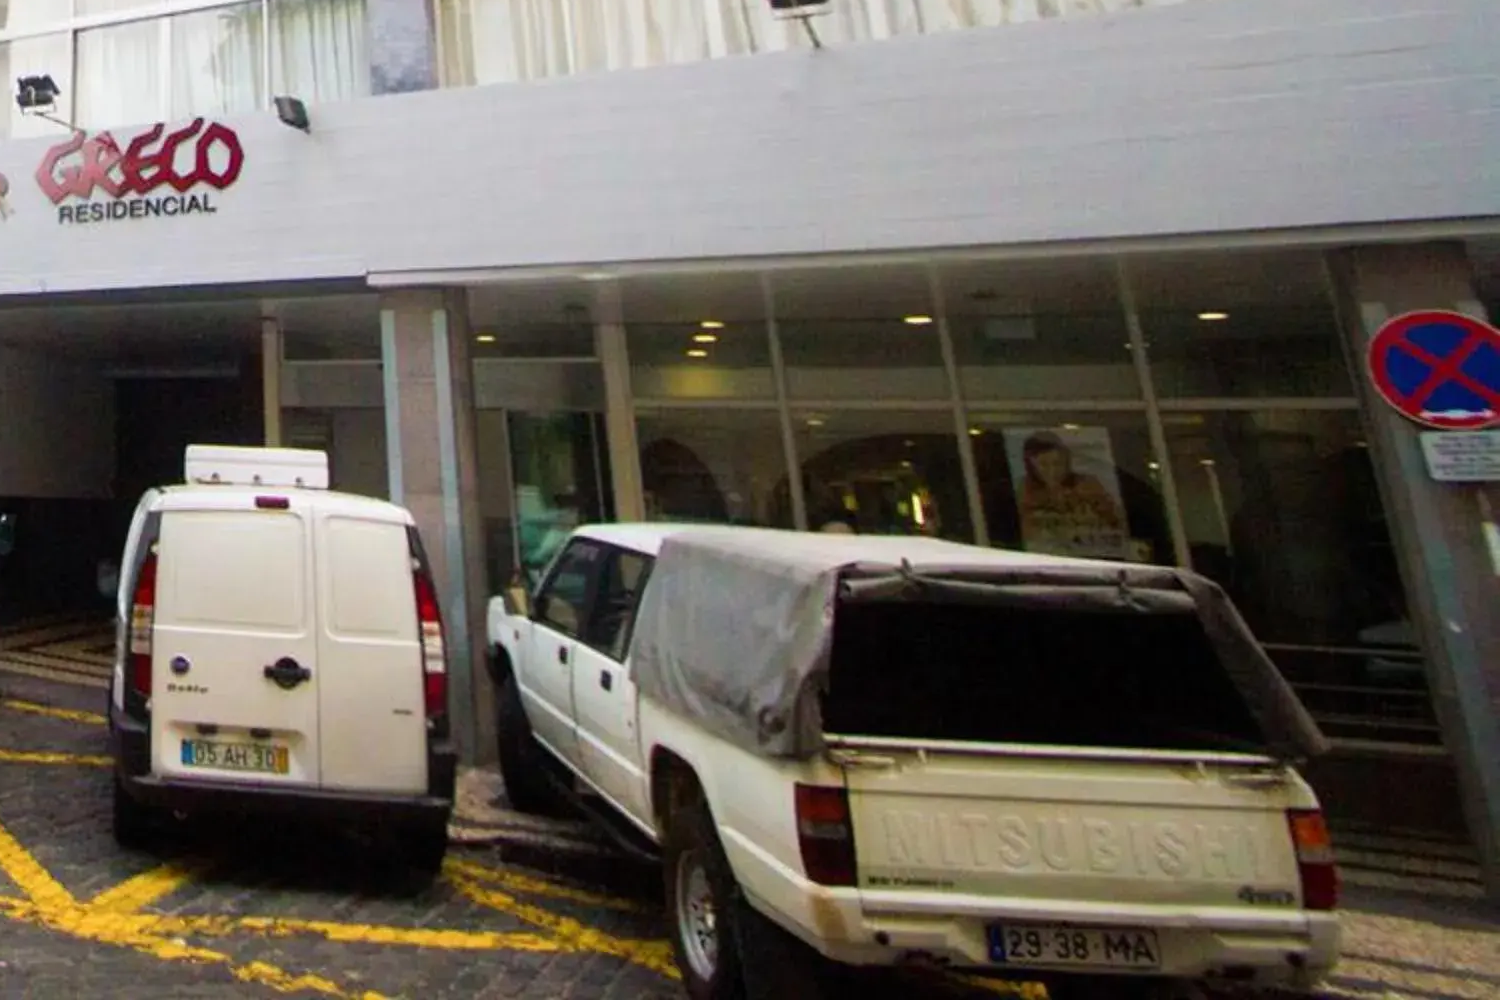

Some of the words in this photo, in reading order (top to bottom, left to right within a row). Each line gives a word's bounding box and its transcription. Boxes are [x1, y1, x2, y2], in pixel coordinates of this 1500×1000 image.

[35, 117, 245, 206] GRECO
[58, 193, 218, 225] RESIDENCIAL
[881, 808, 1271, 880] MITSUBISHI
